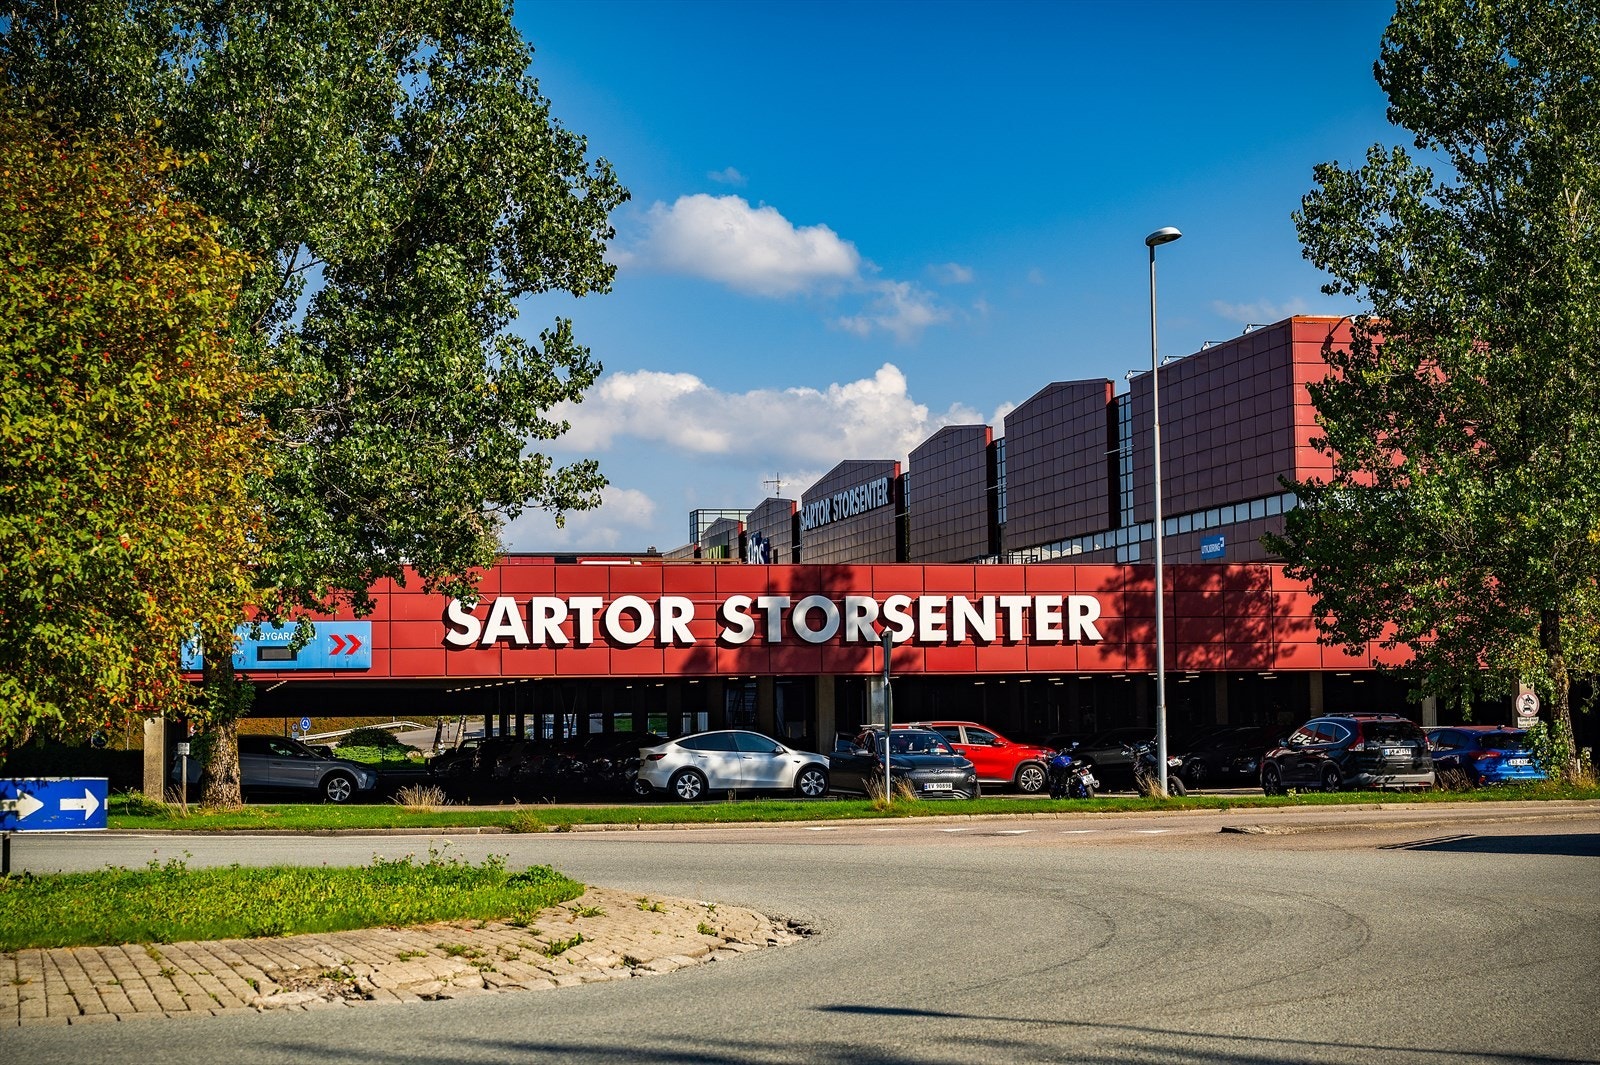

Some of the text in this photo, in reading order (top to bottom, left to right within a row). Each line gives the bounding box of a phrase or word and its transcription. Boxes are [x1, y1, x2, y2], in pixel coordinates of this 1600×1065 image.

[800, 476, 889, 532] SARTOR STORSENTER
[445, 594, 1104, 646] SARTOR STORSENTER
